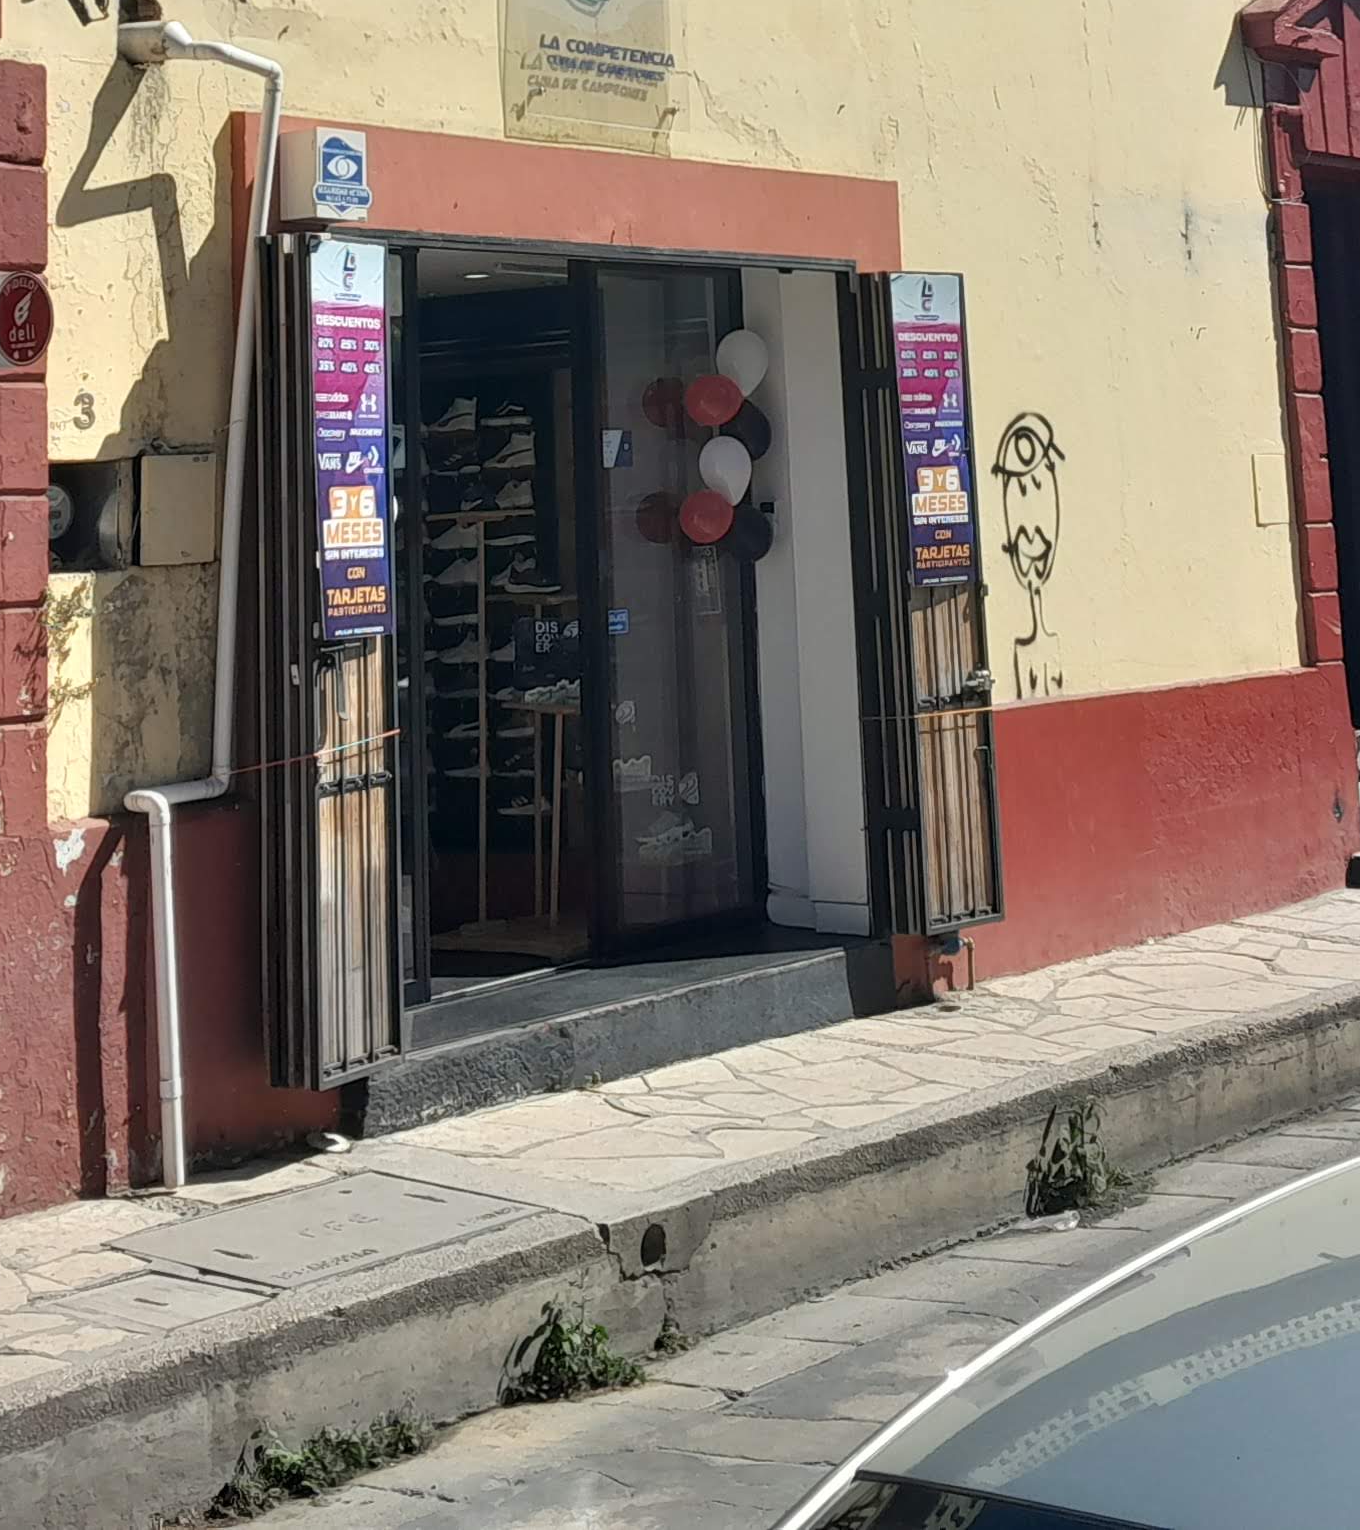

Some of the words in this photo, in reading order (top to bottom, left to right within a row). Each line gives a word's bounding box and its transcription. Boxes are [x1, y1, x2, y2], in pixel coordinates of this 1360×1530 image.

[539, 33, 560, 51] LA
[566, 38, 675, 67] COMPETENCIA
[315, 314, 381, 330] DESCUENTOS
[897, 332, 958, 343] DESCUENTOS
[73, 392, 96, 430] 3
[919, 469, 934, 492] 3
[936, 473, 944, 487] Y
[331, 489, 347, 518] 3
[350, 493, 358, 511] Y
[359, 489, 375, 517] 6
[914, 494, 966, 513] MESES
[326, 521, 382, 545] MESES
[935, 530, 952, 540] CON
[915, 544, 970, 561] TARJETAS
[916, 558, 971, 570] PARTICIPANTES
[347, 566, 366, 580] CON
[326, 586, 386, 606] TARJETAS
[327, 603, 386, 617] PARTICIPANTES
[535, 621, 558, 633] DIS
